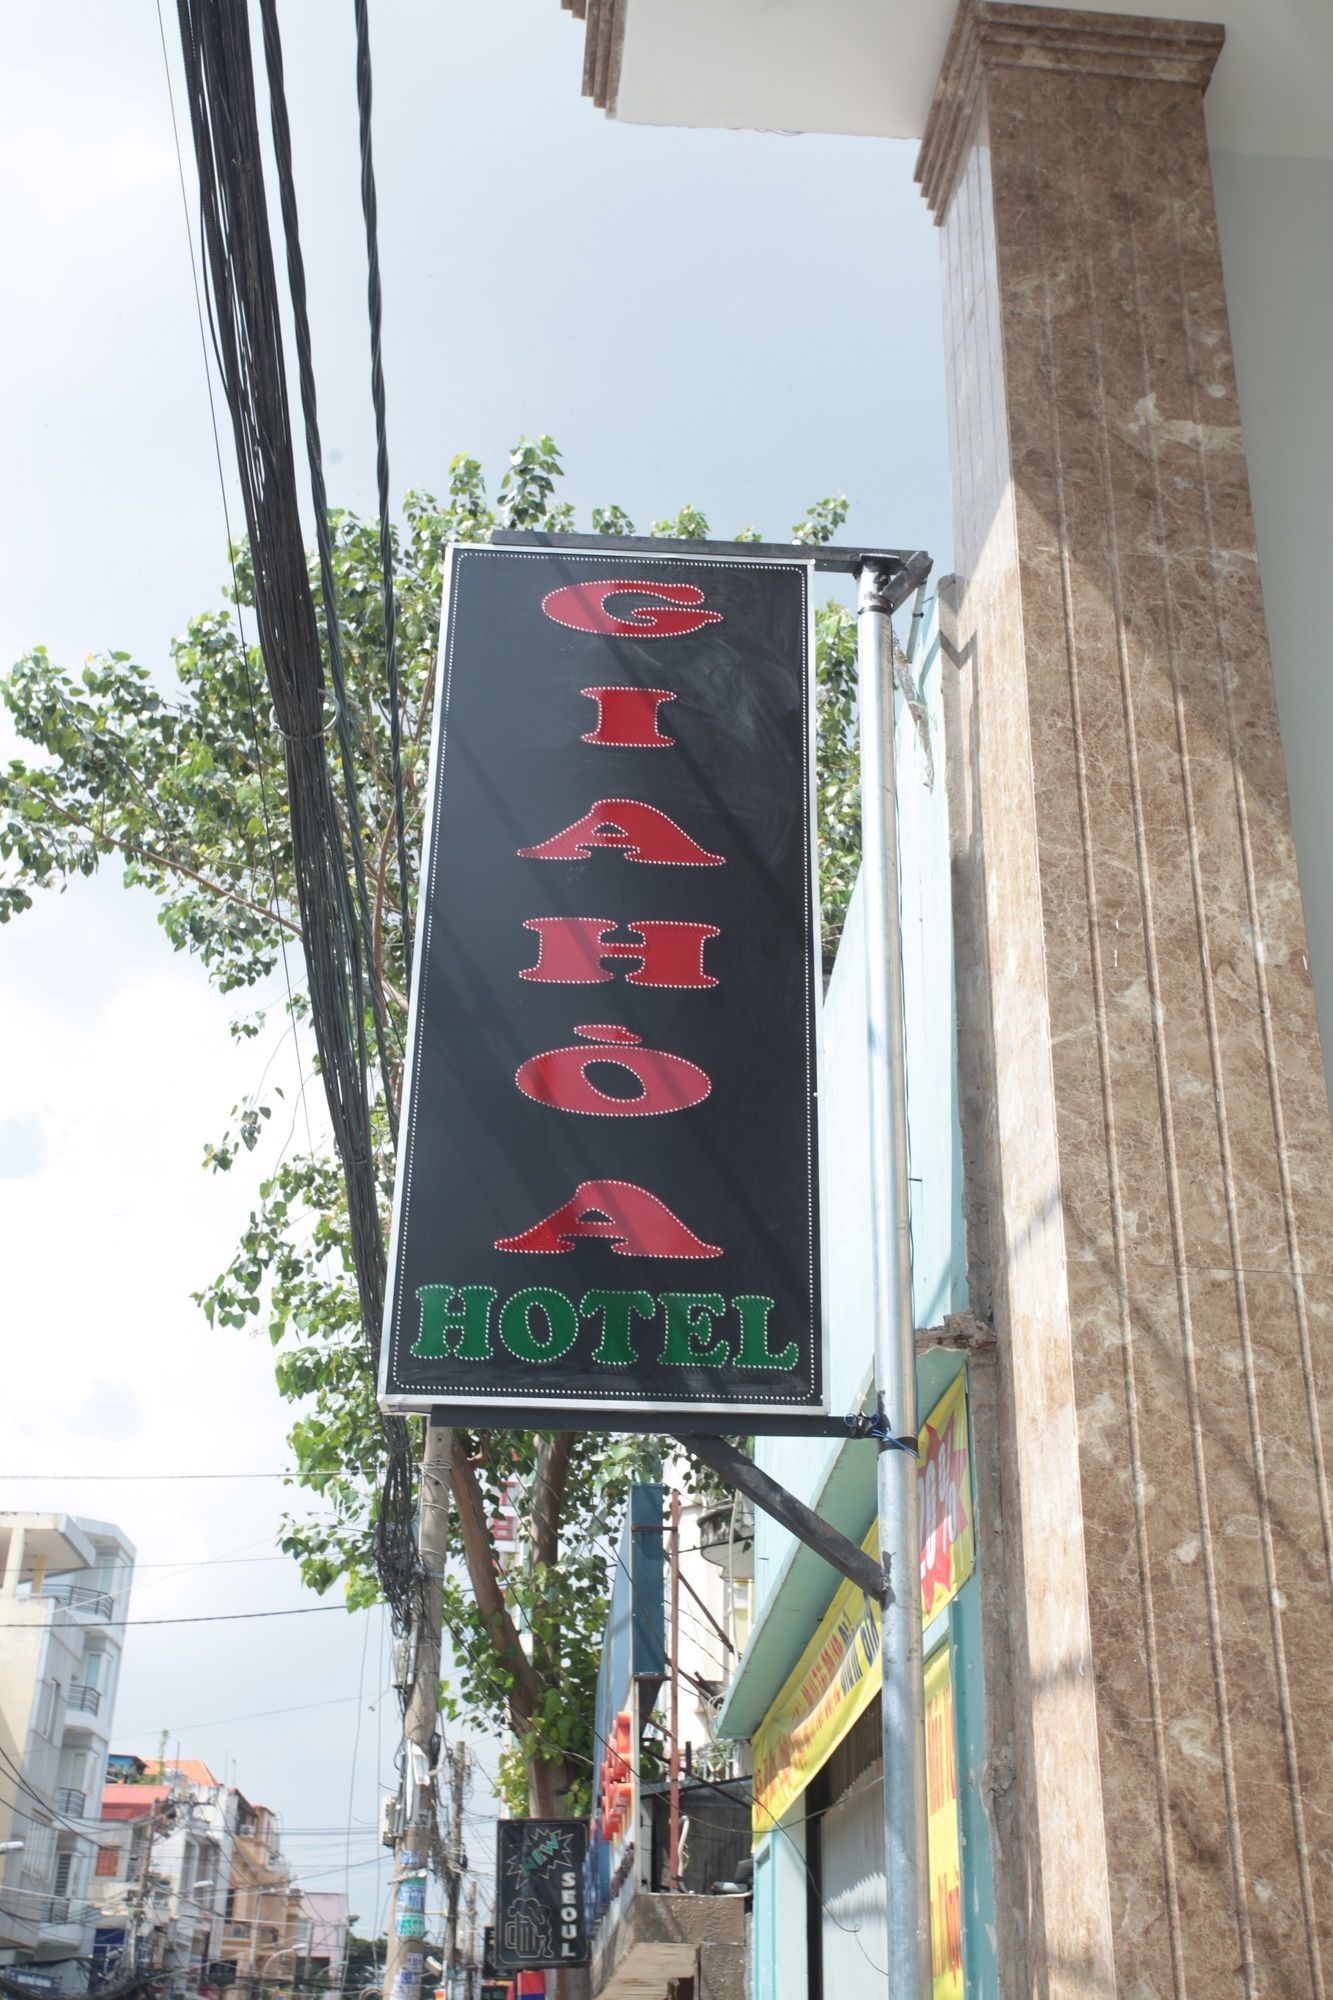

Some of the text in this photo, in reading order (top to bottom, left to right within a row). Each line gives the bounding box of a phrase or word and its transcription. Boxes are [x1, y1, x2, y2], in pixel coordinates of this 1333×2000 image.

[410, 1283, 800, 1371] HOTEL
[520, 1833, 560, 1878] NEW
[561, 1871, 578, 1957] SEOUL
